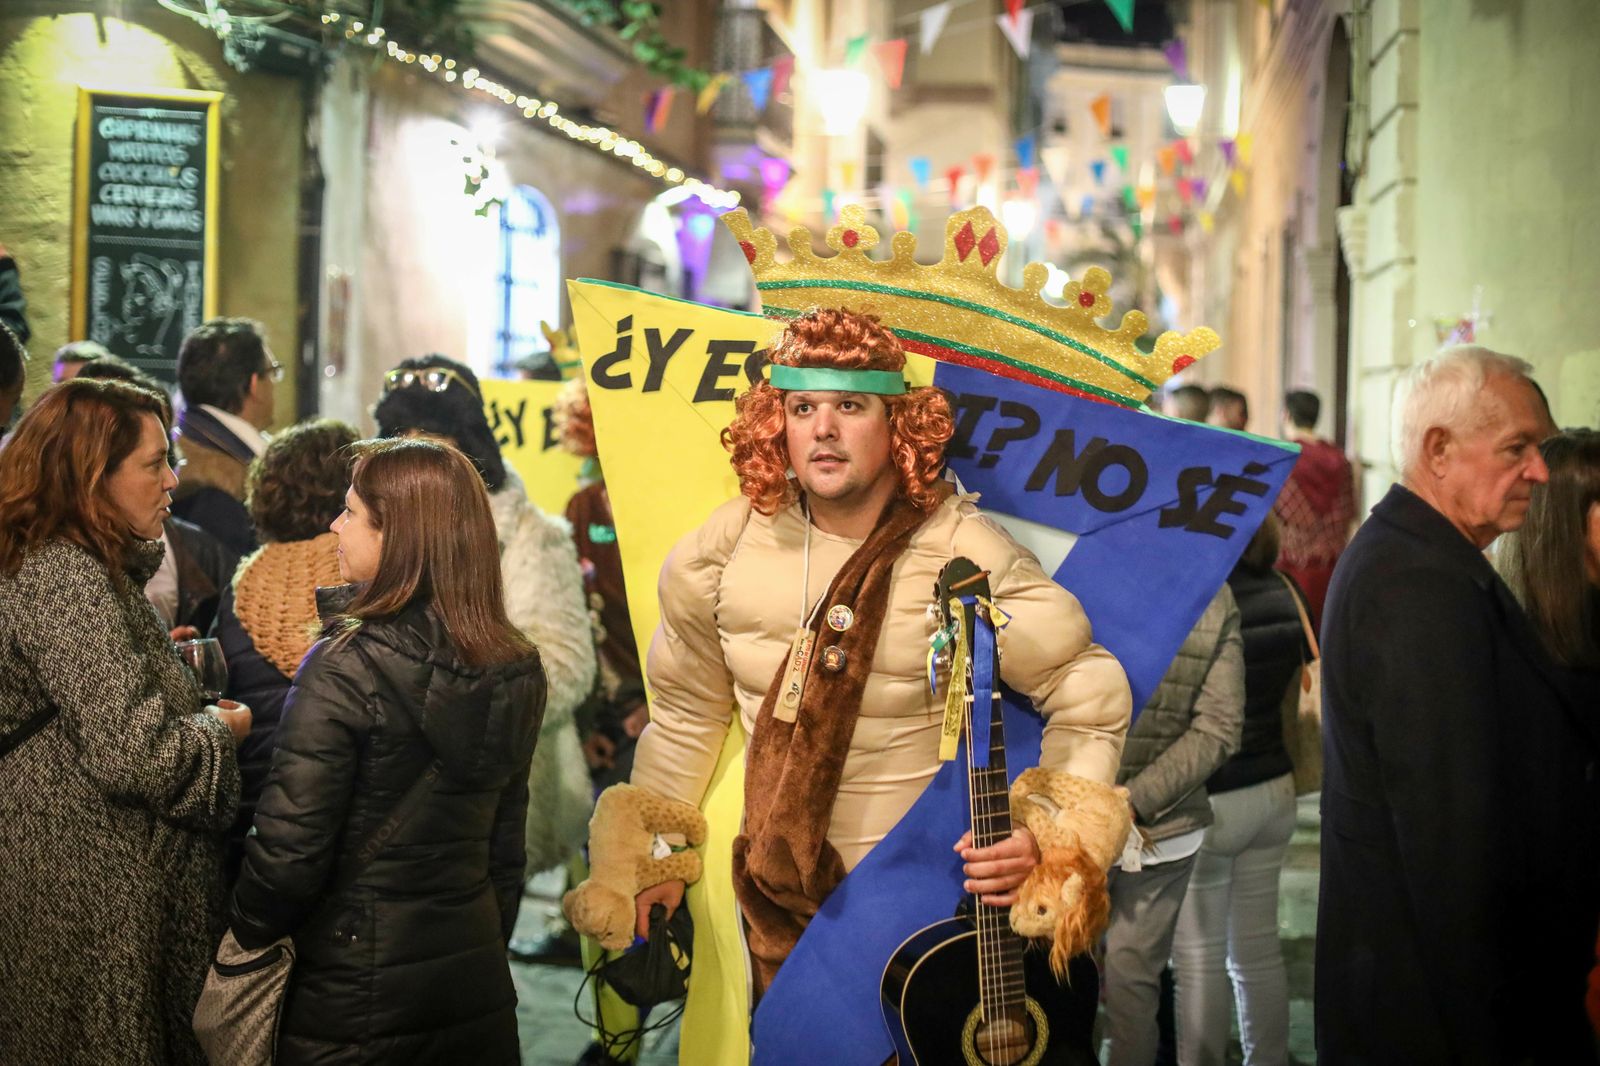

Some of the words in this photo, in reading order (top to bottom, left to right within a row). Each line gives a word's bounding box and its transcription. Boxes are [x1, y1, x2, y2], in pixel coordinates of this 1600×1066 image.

[99, 183, 198, 210] CERVEZAS
[591, 314, 695, 394] ¿Y
[1025, 429, 1149, 513] NO
[1158, 461, 1271, 539] SÉ
[358, 817, 401, 862] TOUS
